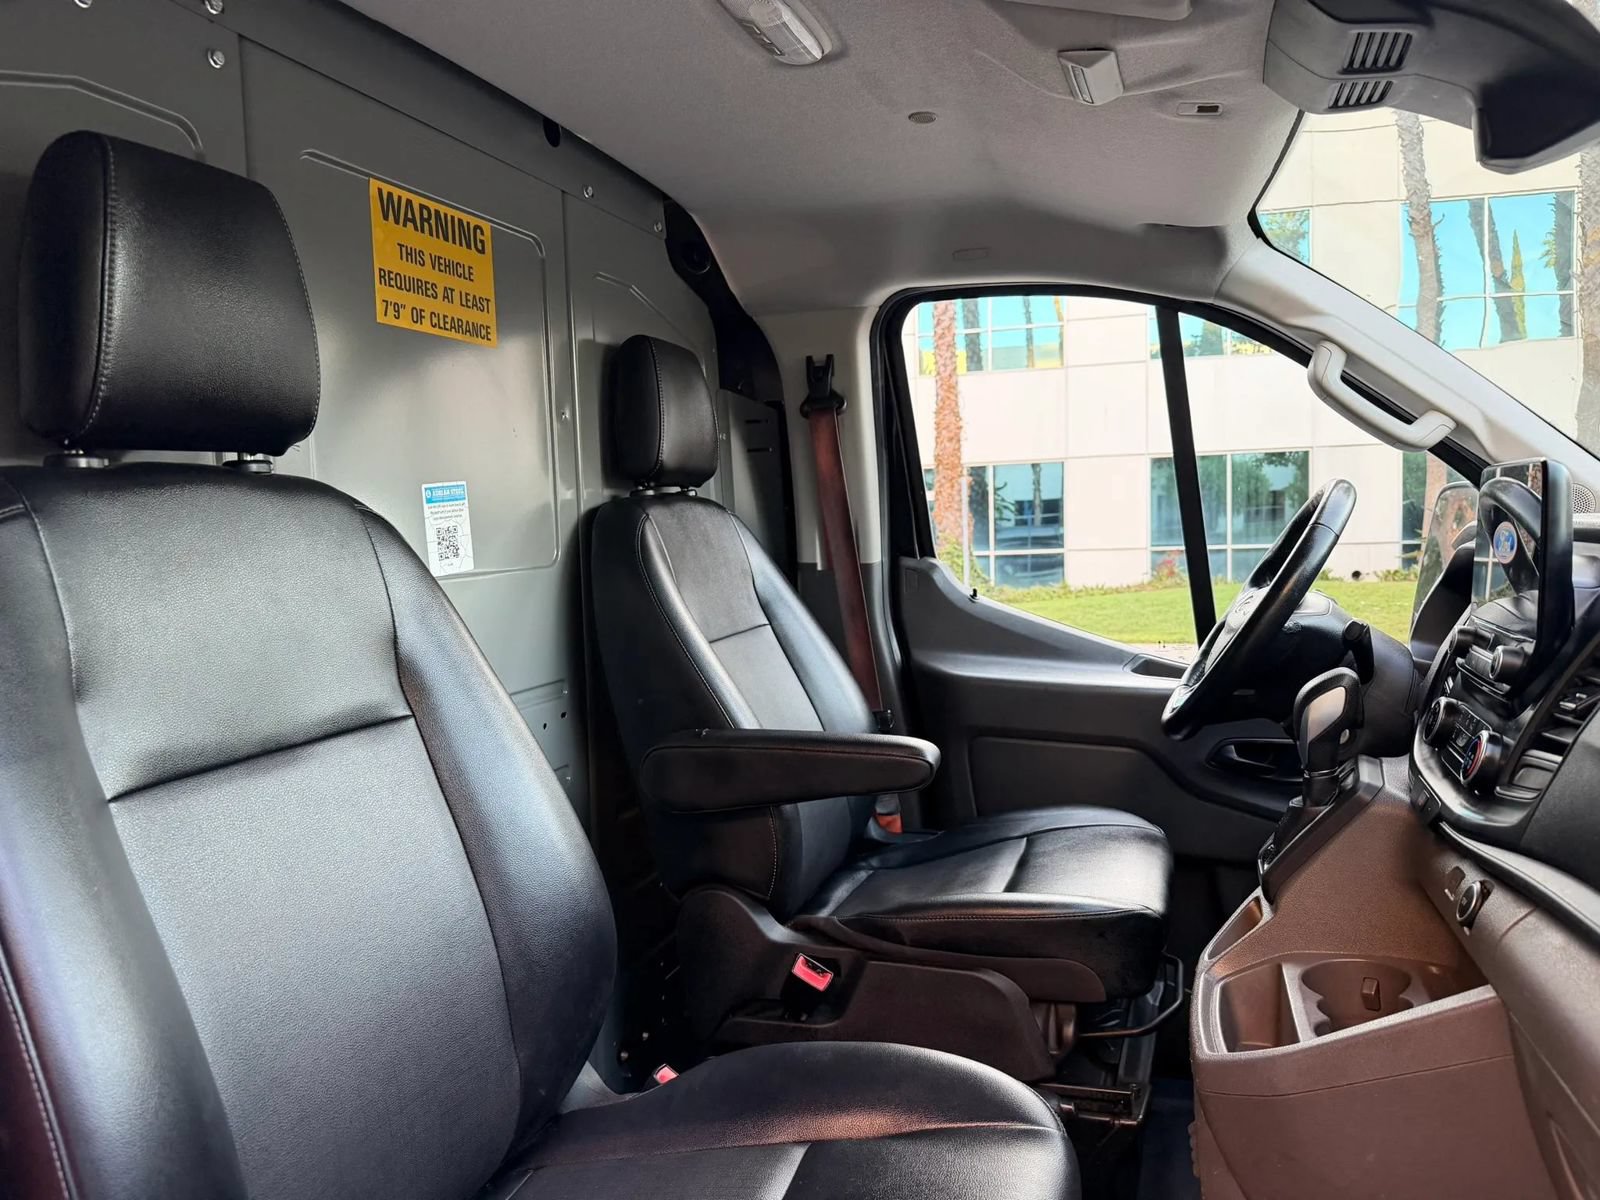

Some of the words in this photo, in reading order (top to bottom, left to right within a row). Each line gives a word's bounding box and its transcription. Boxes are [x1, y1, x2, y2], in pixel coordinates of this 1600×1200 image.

[377, 187, 486, 255] WARNING
[397, 242, 425, 267] THIS
[429, 253, 474, 282] VEHICLE
[378, 267, 438, 299] REQUIRES
[442, 286, 455, 304] AT
[459, 290, 491, 314] LEAST
[411, 306, 425, 325] OF
[429, 311, 492, 341] CLEARANCE
